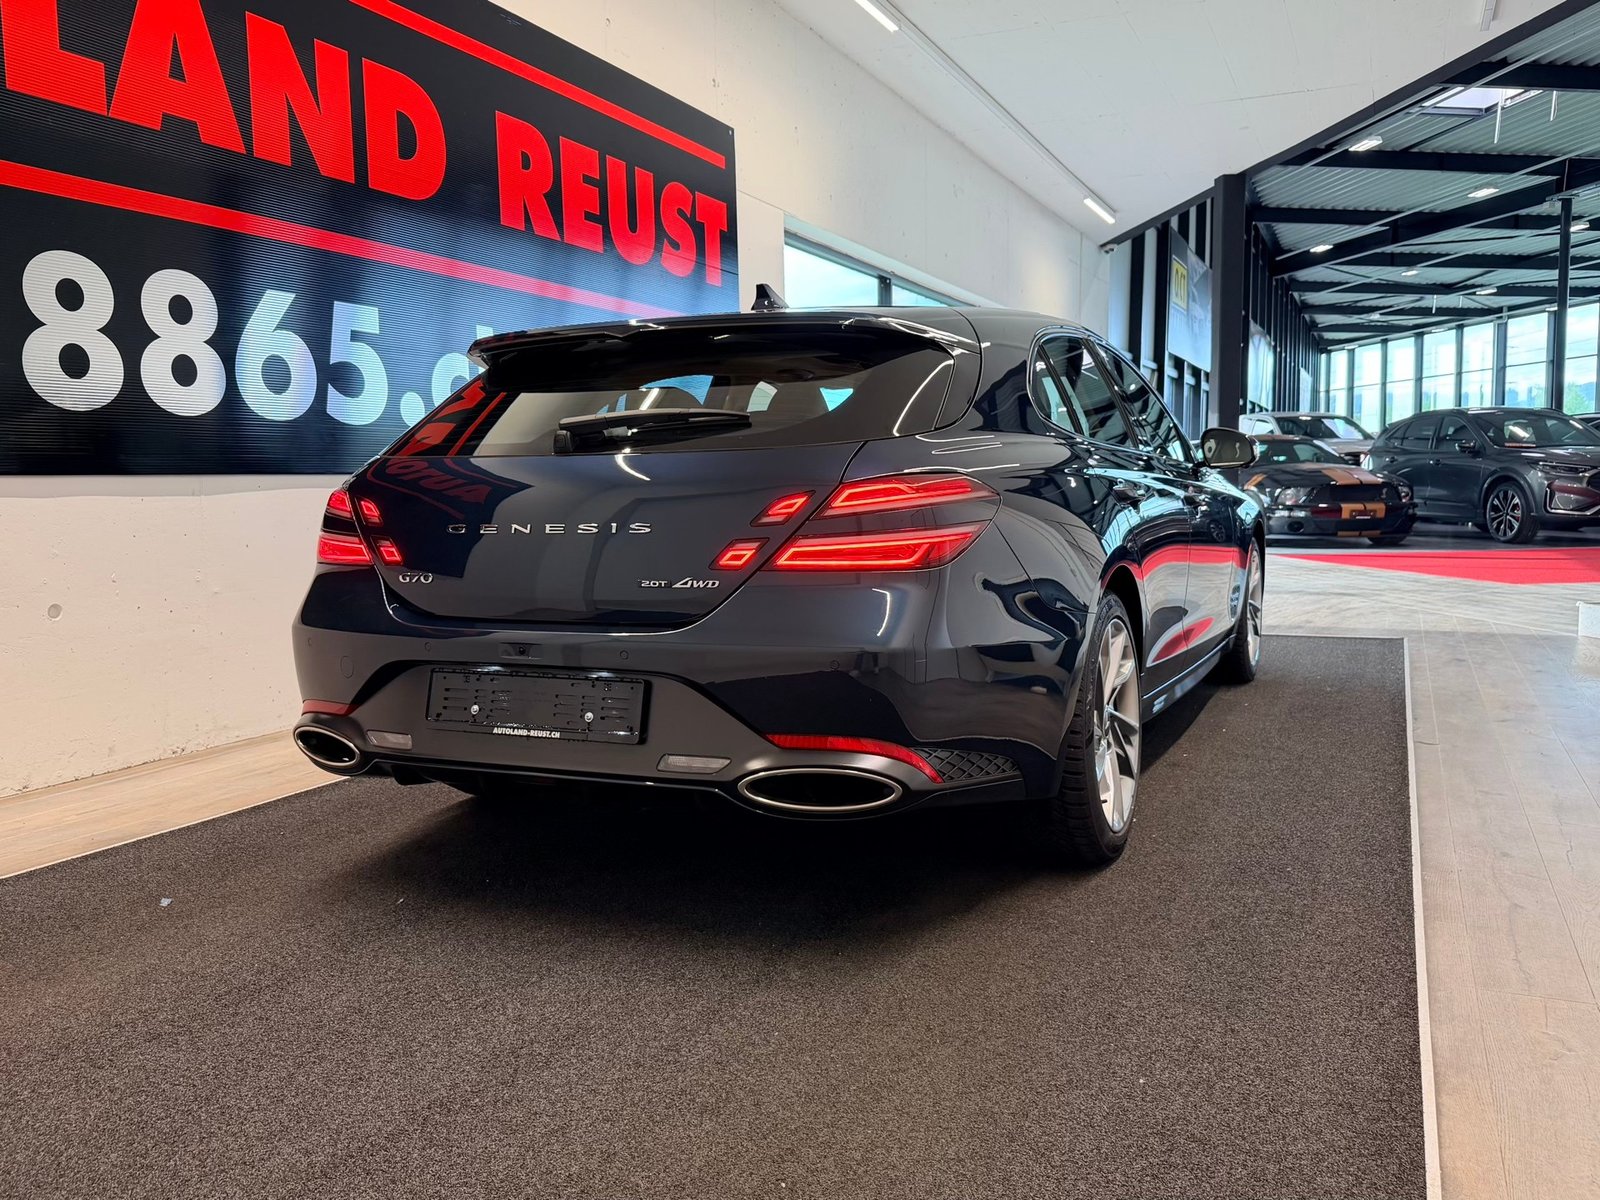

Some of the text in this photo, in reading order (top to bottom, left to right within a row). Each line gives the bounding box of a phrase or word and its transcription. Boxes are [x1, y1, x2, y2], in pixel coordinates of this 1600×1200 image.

[495, 110, 728, 287] REUST
[447, 522, 653, 535] GENESIS
[398, 572, 434, 584] G70
[492, 727, 561, 739] AUTOLAND-REUST.CH
